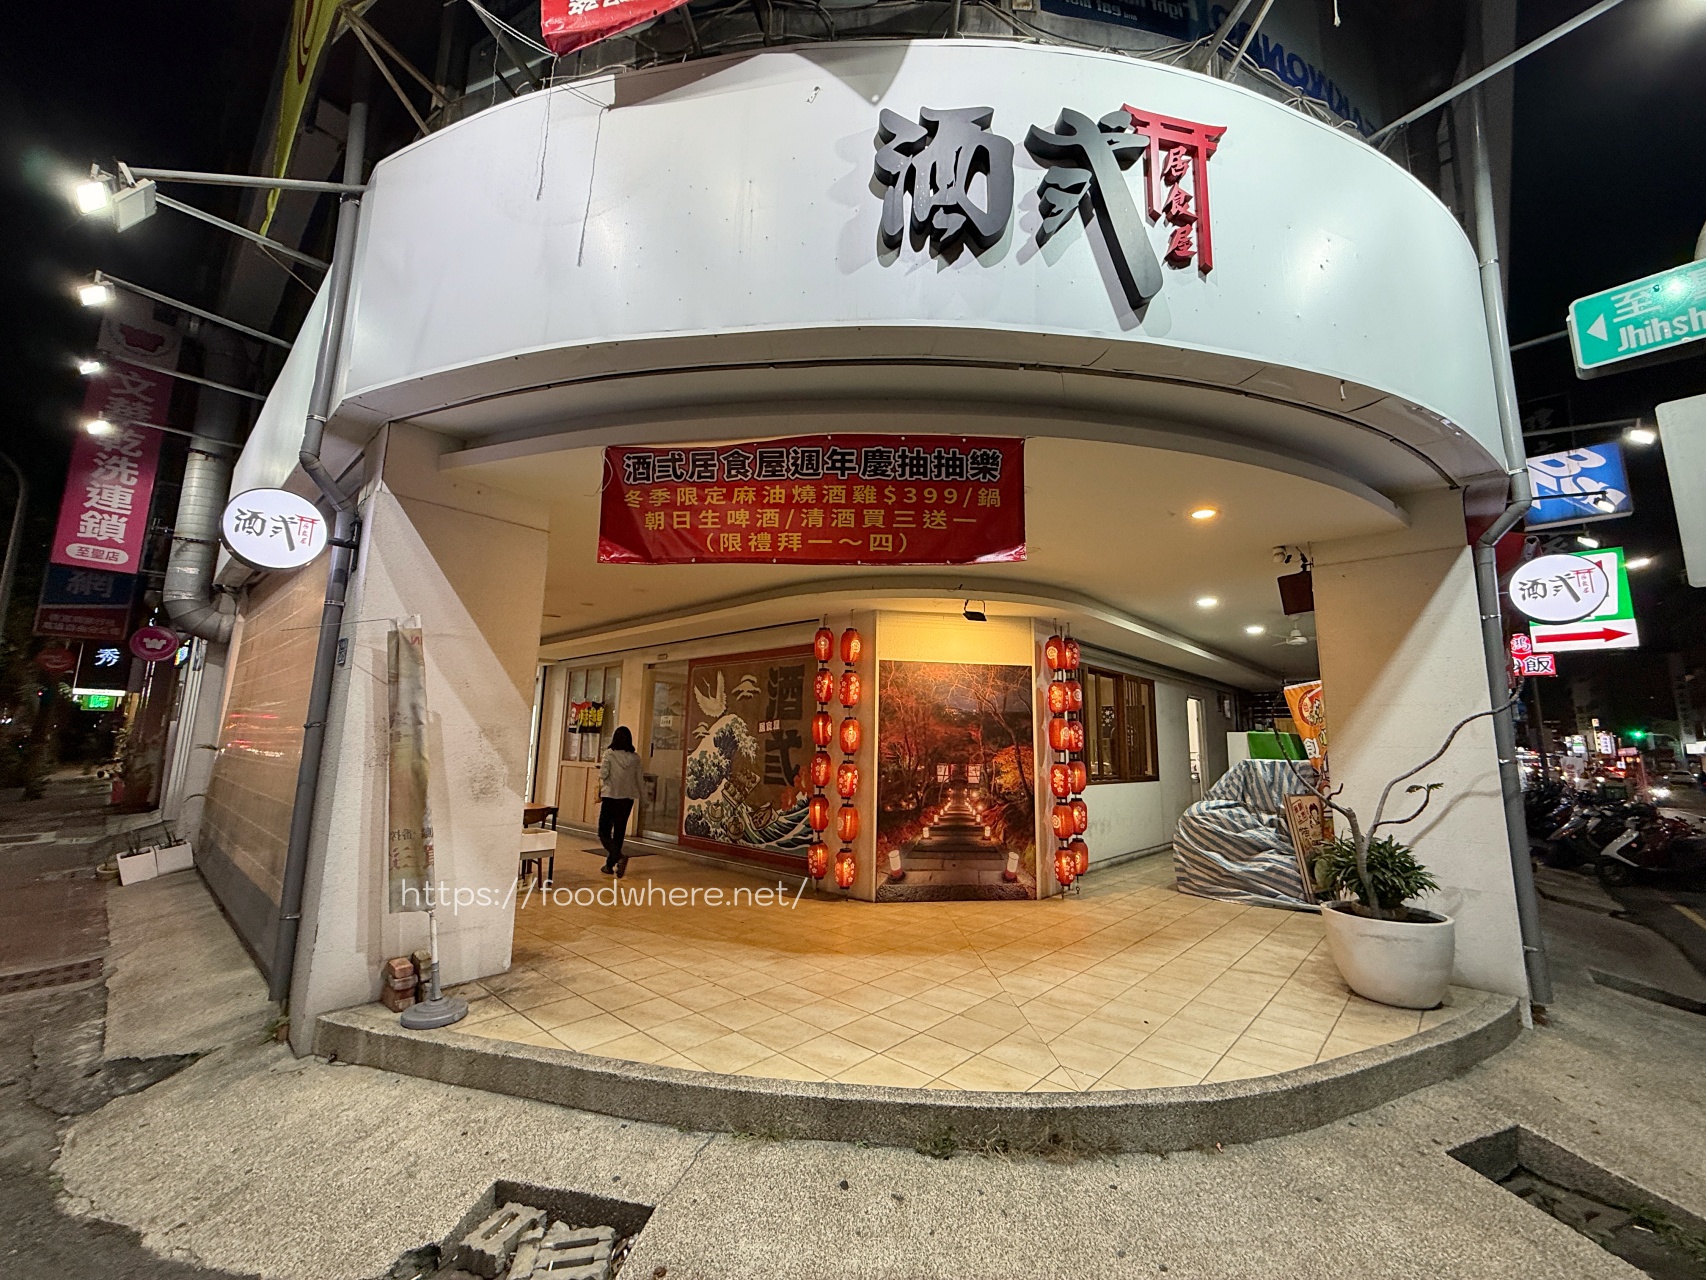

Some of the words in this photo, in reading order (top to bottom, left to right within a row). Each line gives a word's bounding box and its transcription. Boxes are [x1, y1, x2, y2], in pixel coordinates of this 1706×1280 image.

[1161, 145, 1198, 262] 居食屋
[624, 485, 1001, 508] 冬季限定麻油燒酒雞$399/鍋
[644, 508, 977, 531] 朝日生啤酒/清酒買三送一
